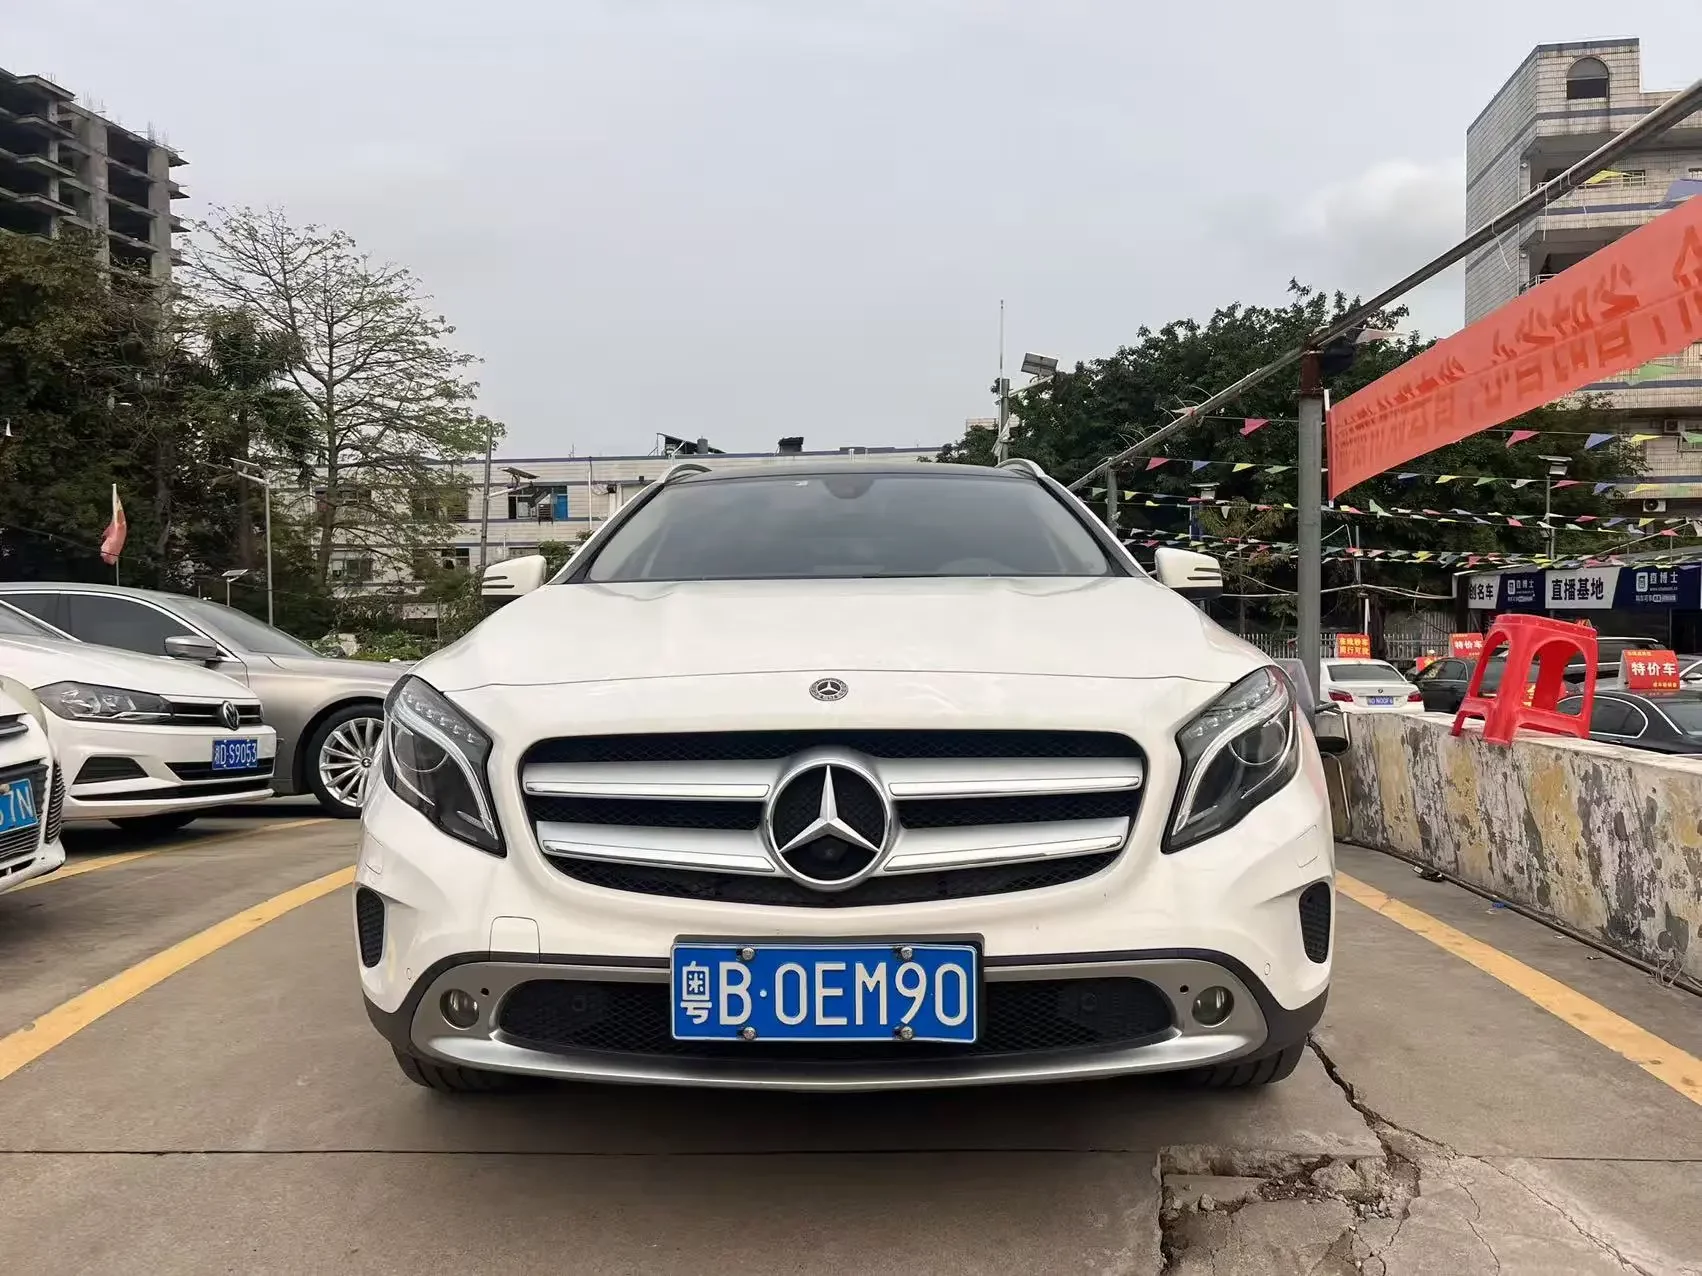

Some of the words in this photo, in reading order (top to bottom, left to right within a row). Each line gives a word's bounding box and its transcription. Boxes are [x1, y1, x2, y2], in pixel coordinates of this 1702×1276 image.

[1551, 578, 1604, 601] 直播基地
[1631, 661, 1677, 676] 特价车
